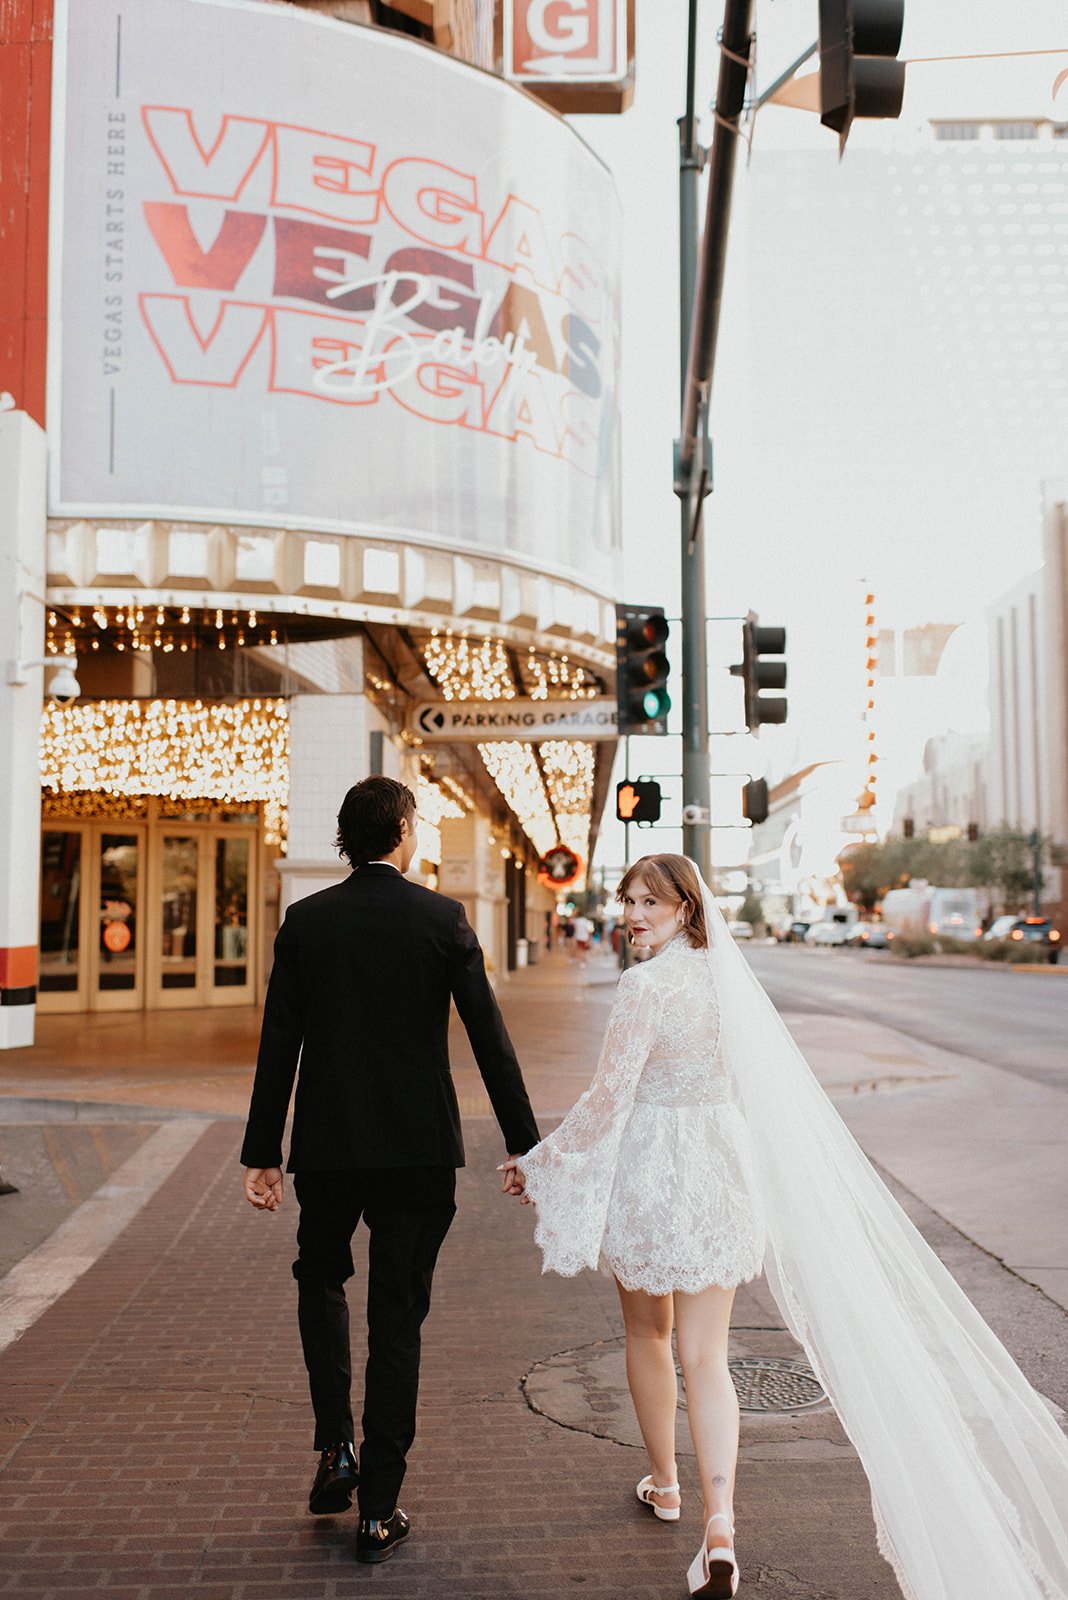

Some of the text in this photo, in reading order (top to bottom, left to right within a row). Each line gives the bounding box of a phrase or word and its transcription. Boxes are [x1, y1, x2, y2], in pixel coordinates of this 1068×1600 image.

[526, 0, 589, 53] G
[103, 111, 126, 377] VEGAS STARTS HERE
[141, 105, 603, 322] VEGAS
[143, 201, 602, 400] VEGAS
[138, 292, 603, 479] VEGAS
[313, 271, 538, 396] Baby
[452, 711, 536, 727] PARKING
